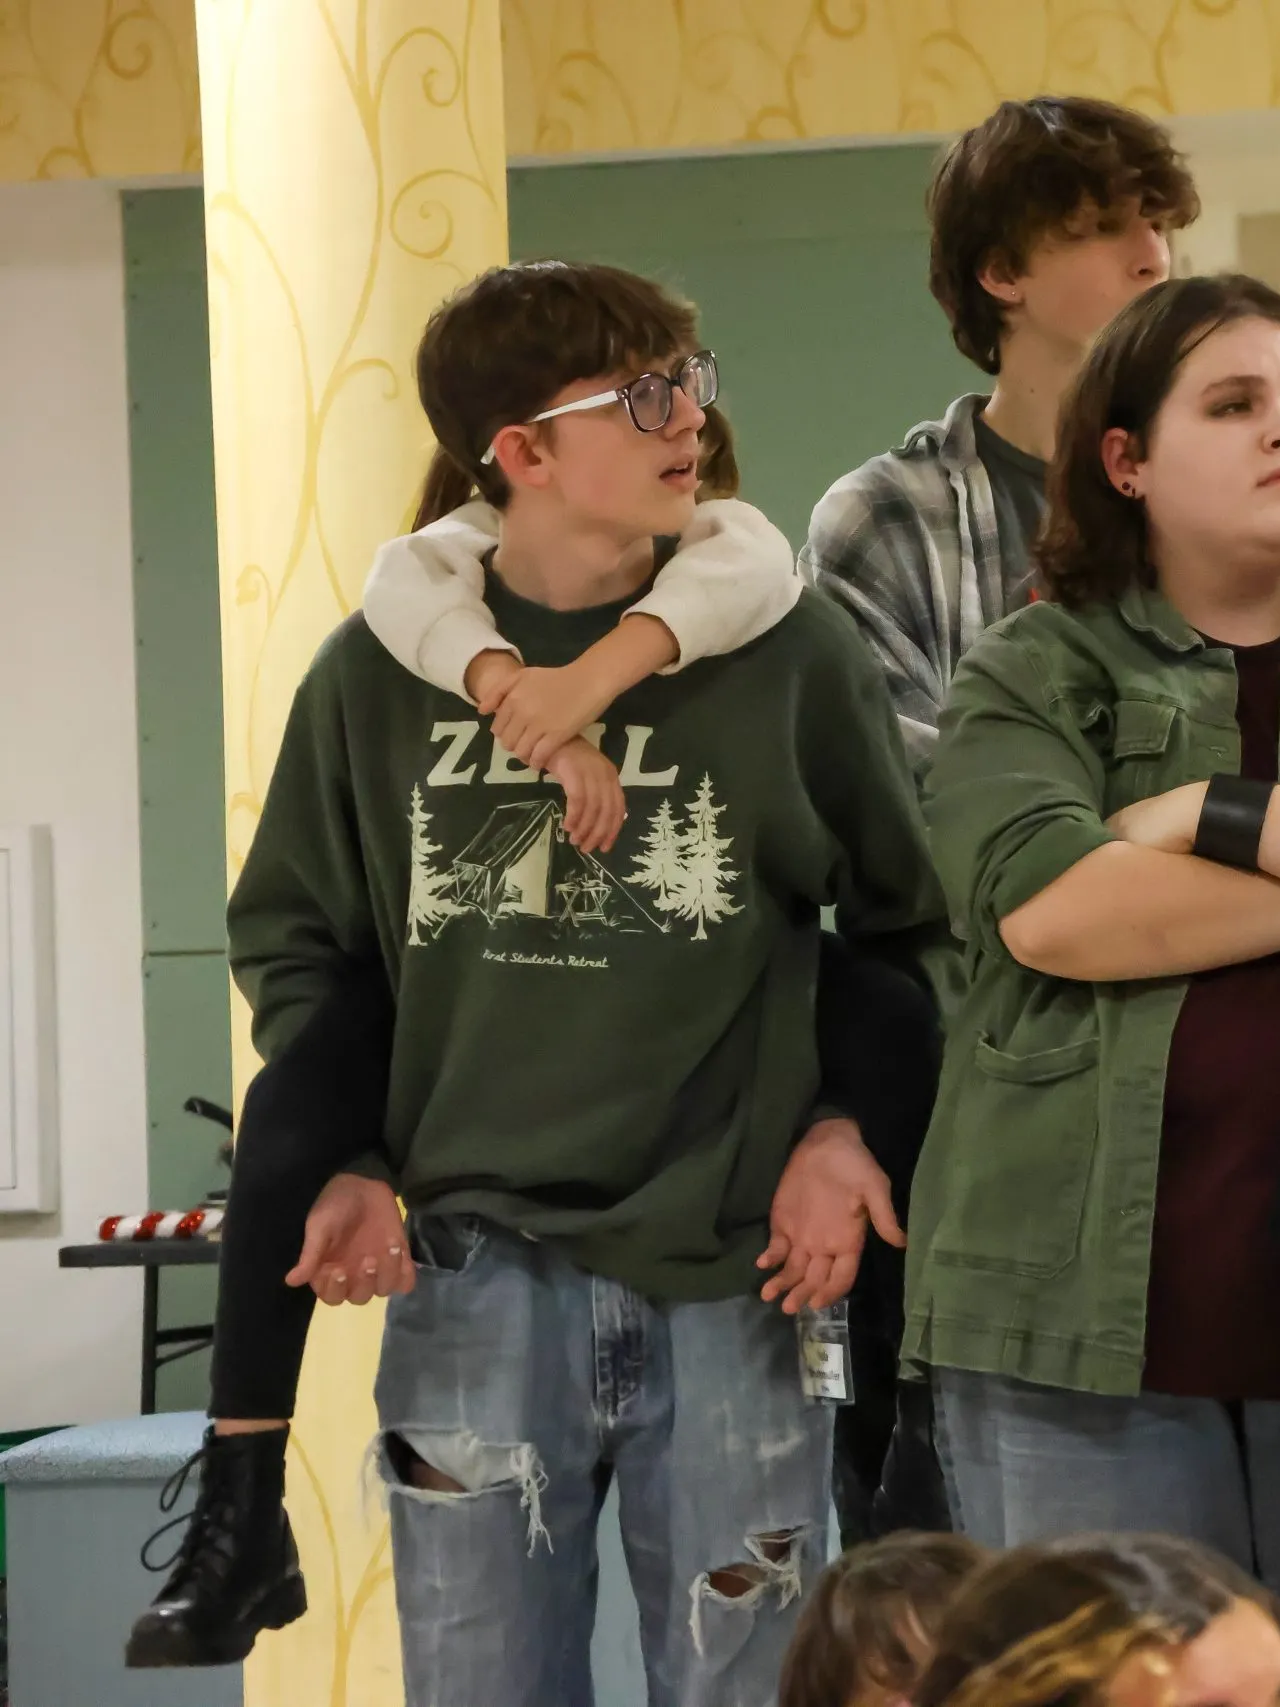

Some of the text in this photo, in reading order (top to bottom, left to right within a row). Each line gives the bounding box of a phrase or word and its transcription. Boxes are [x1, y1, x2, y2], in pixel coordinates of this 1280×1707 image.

[426, 720, 680, 786] ZEL
[509, 952, 565, 966] Students
[567, 954, 609, 968] Retreat
